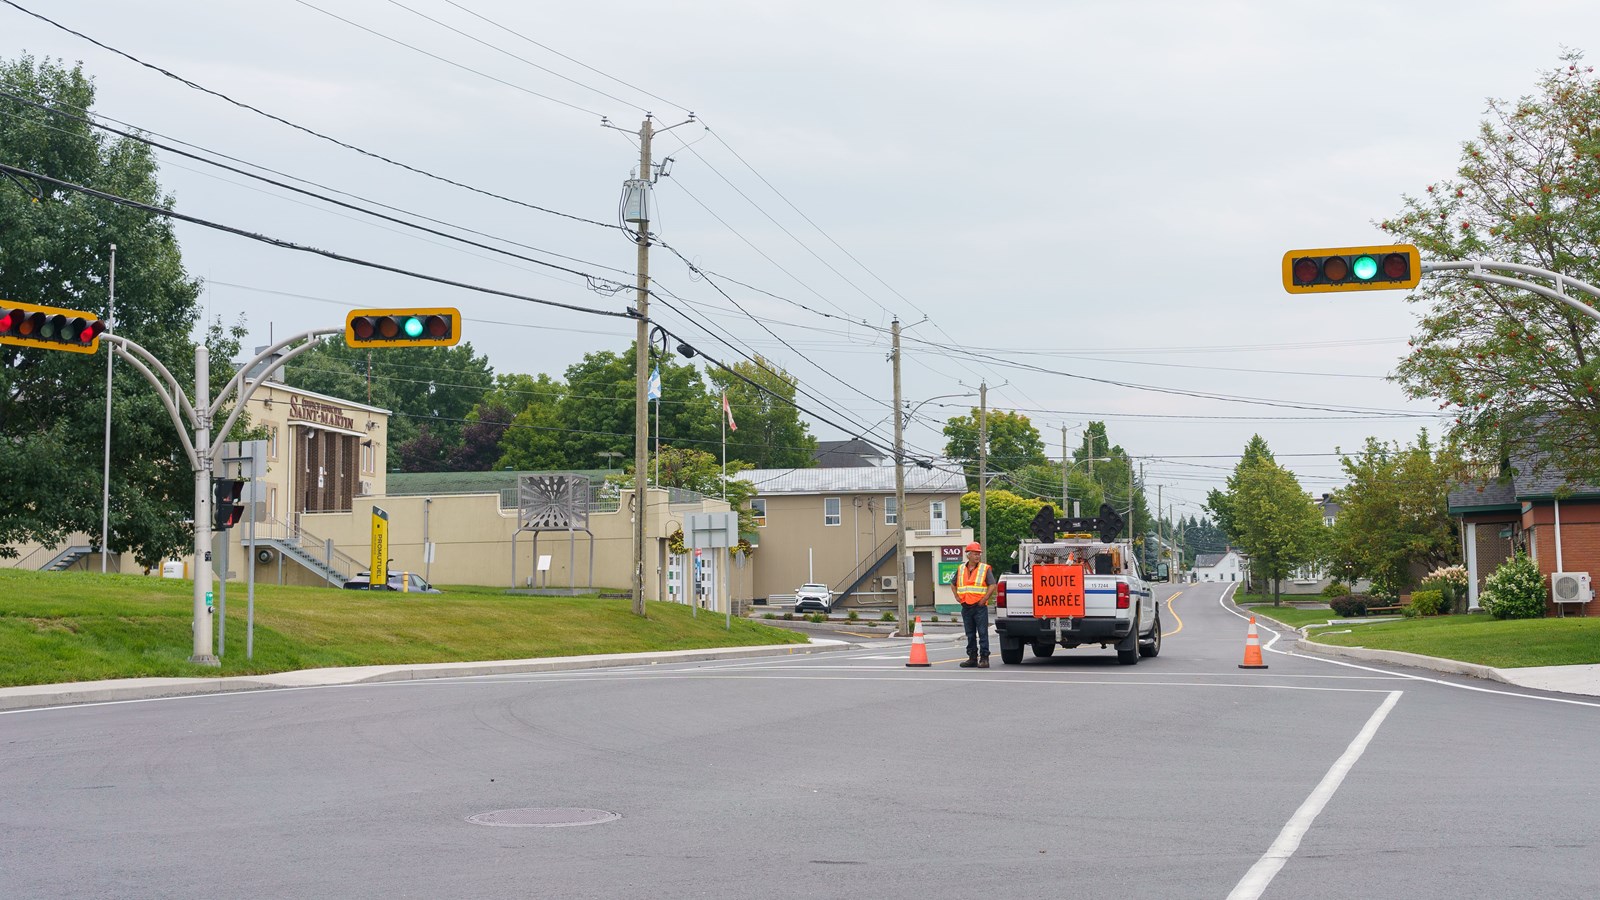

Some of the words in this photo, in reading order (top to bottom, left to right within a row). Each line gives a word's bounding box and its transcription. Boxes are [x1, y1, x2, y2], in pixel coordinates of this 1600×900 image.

[289, 394, 354, 429] SAINT-MARTIN
[943, 548, 961, 556] SAQ
[1040, 575, 1076, 587] ROUTE
[1037, 592, 1081, 607] BARRÉE
